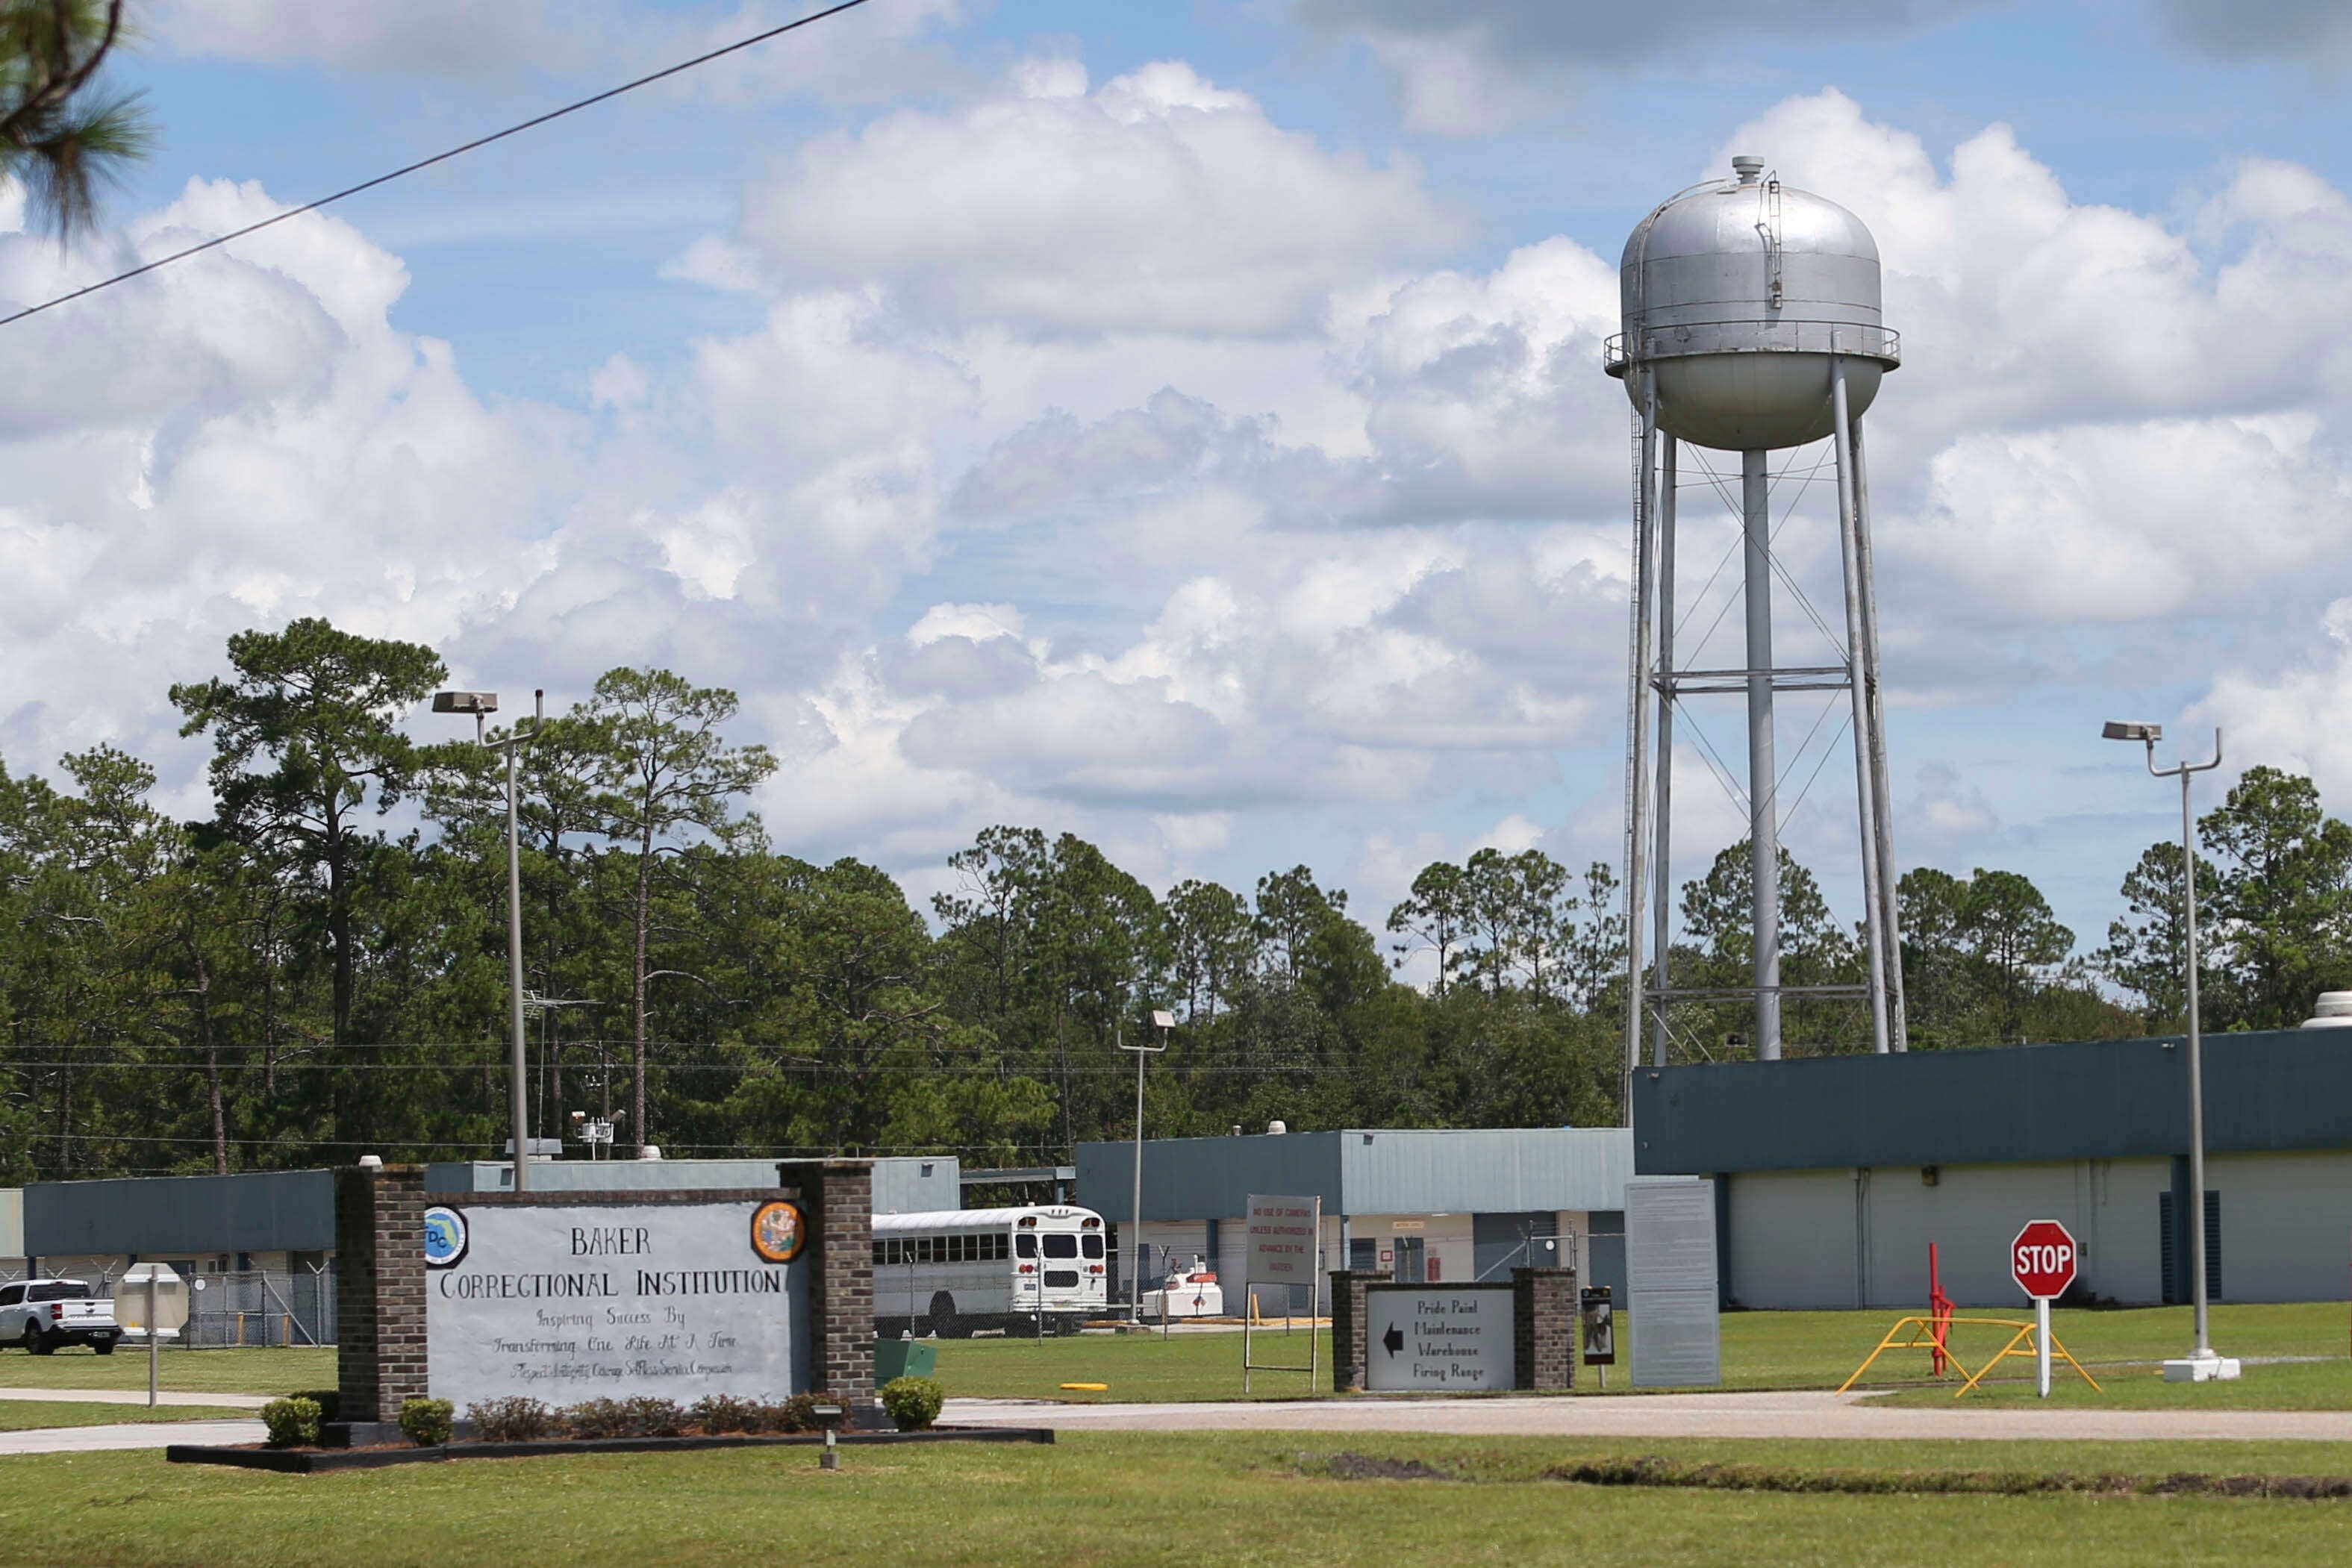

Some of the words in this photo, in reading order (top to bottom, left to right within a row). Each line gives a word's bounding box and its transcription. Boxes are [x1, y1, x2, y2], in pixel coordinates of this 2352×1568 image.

[571, 1227, 651, 1255] BAKER
[2017, 1245, 2071, 1275] STOP
[440, 1272, 618, 1299] CORRECTIONAL
[637, 1269, 781, 1296] INSTITUTION
[1417, 1300, 1446, 1314] Pride
[537, 1308, 593, 1331] Inspiring
[606, 1307, 652, 1325] Success
[663, 1306, 685, 1331] By
[1414, 1321, 1481, 1335] Maintenance
[625, 1334, 651, 1351] Life
[1413, 1362, 1446, 1381] Firing
[1451, 1363, 1484, 1381] Range
